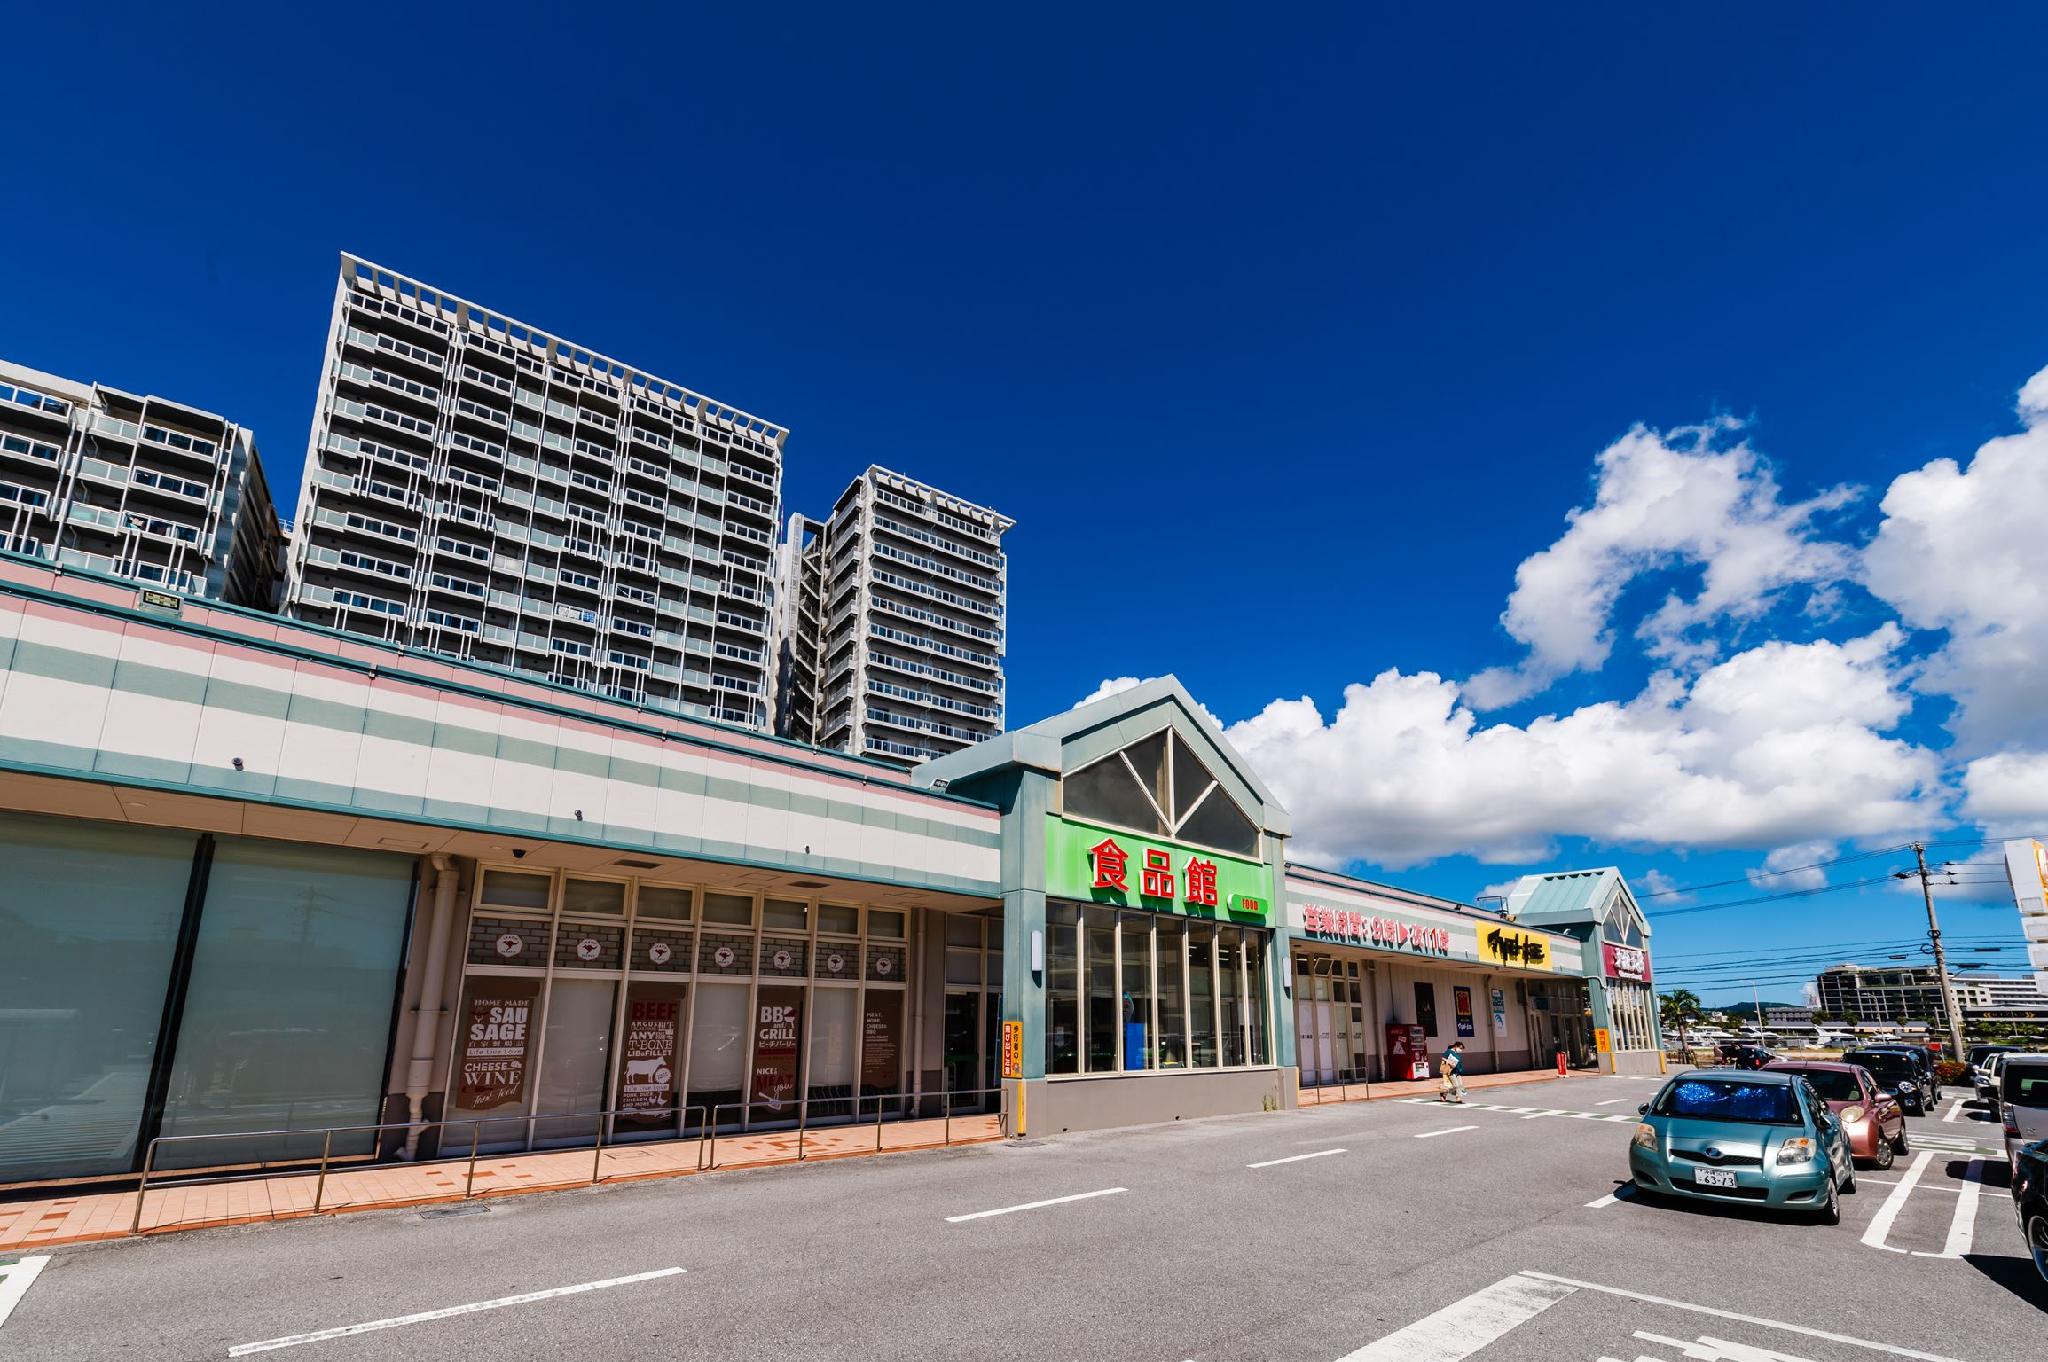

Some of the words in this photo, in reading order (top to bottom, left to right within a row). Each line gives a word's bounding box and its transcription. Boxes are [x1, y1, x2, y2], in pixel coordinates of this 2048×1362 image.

[1089, 838, 1218, 906] 食品館
[1242, 898, 1258, 911] FOOD
[490, 1007, 528, 1023] SAU
[632, 1003, 677, 1019] BEEF
[470, 1024, 526, 1040] SAGE
[760, 1029, 796, 1039] GRILL
[465, 1062, 507, 1071] CHEESE
[464, 1071, 521, 1085] WINE
